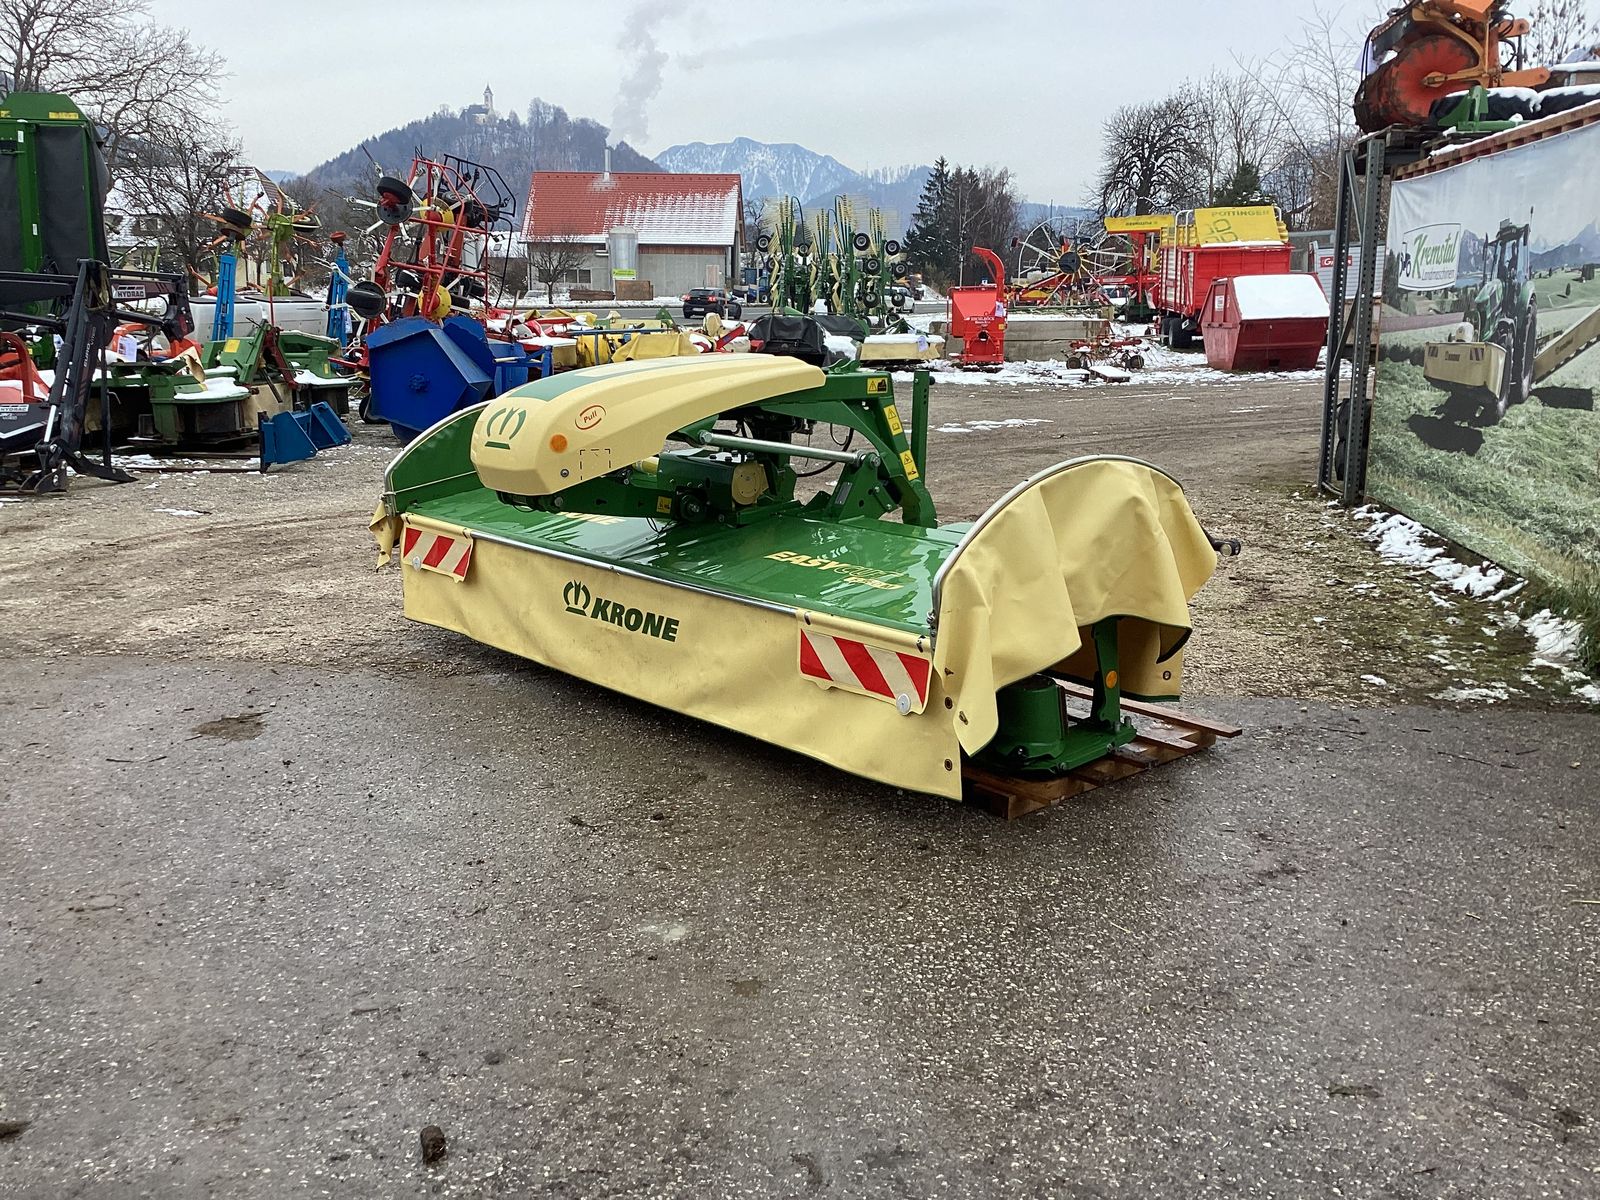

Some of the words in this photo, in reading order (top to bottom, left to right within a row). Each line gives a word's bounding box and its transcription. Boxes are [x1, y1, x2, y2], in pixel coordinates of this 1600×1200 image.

[1412, 231, 1460, 279] Kremstal
[117, 290, 145, 298] HYDRAC
[583, 410, 597, 423] Pull
[590, 597, 680, 642] KRONE
